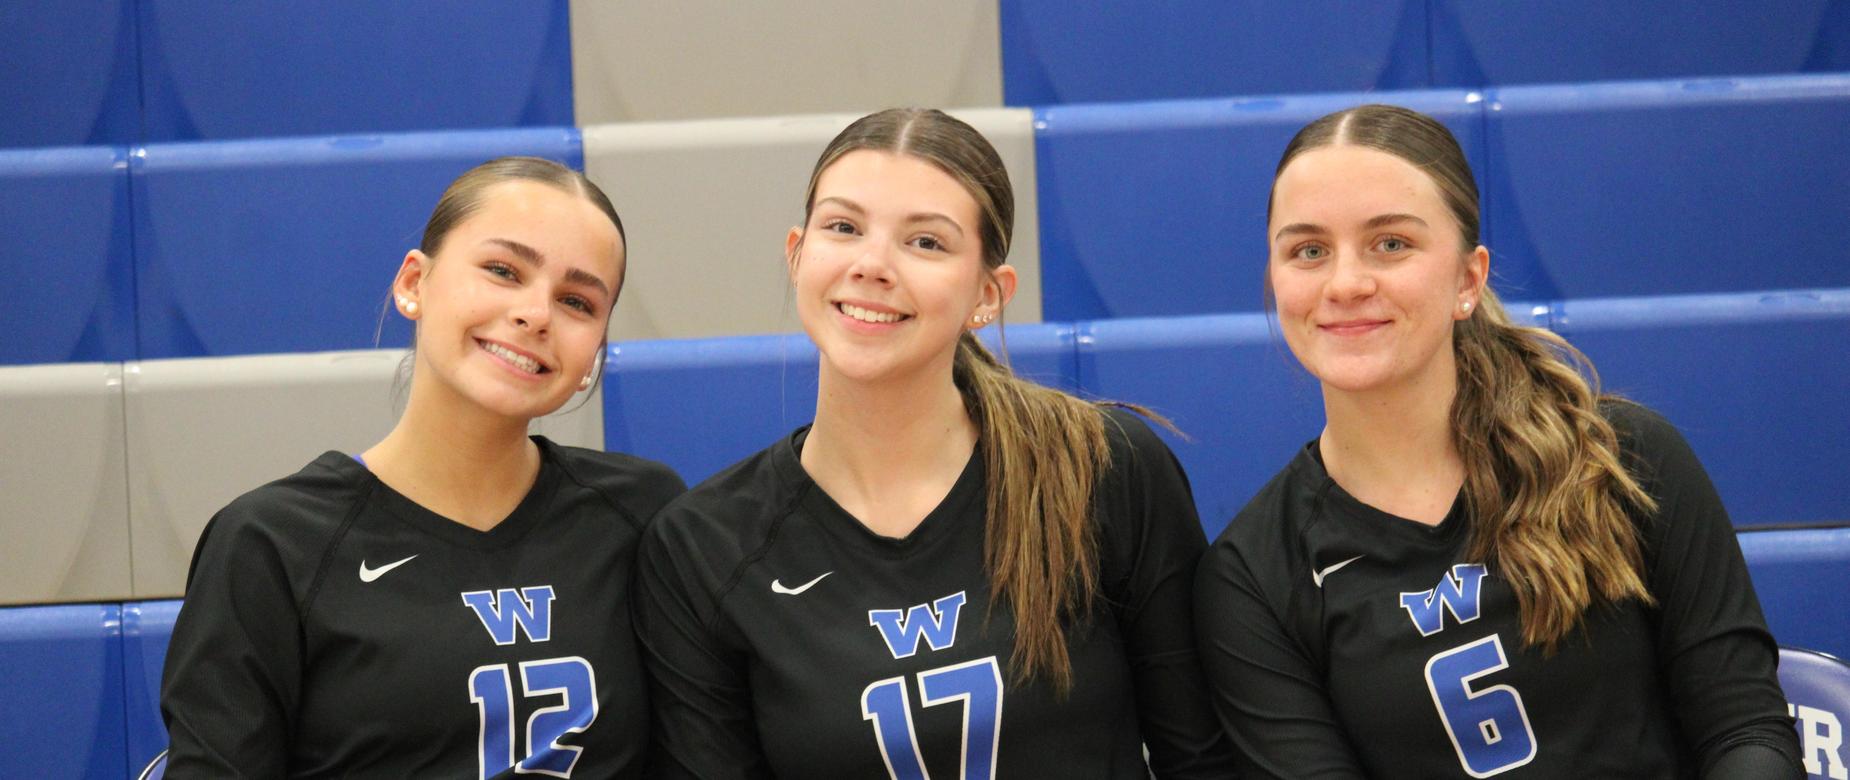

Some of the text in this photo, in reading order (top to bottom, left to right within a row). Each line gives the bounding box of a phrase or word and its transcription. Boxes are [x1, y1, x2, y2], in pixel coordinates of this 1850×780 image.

[461, 585, 556, 645] W
[868, 590, 966, 659] W
[1400, 563, 1488, 637] W
[468, 656, 599, 780] 12
[861, 655, 1003, 780] 17
[1424, 633, 1537, 779] 6
[1787, 703, 1848, 780] R
